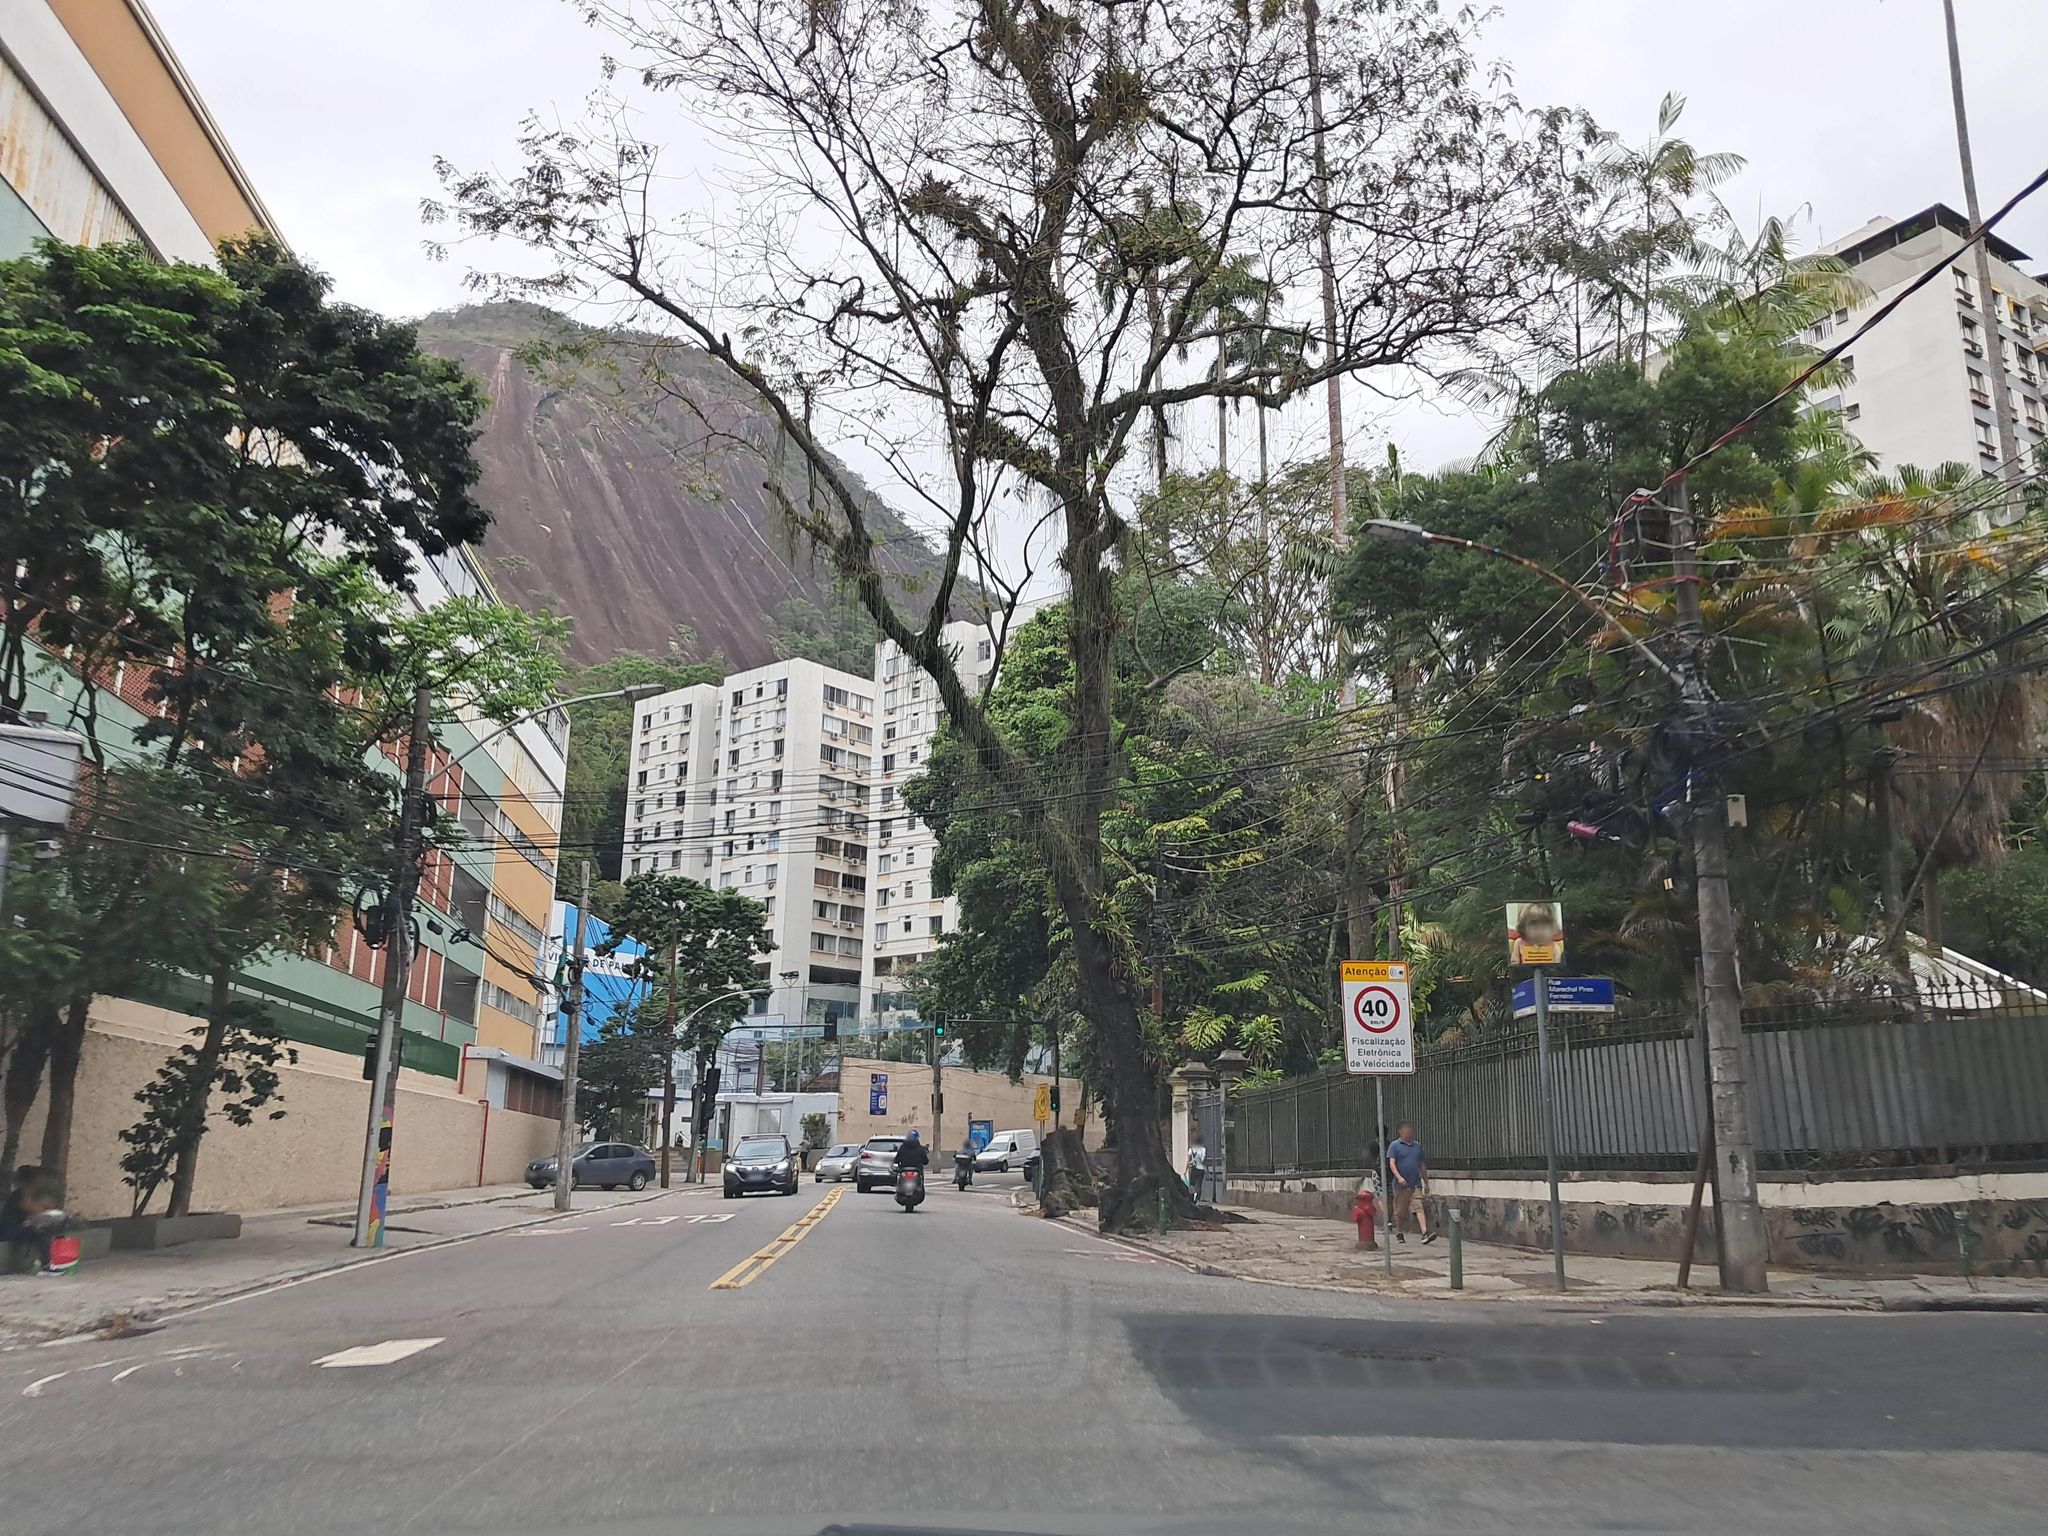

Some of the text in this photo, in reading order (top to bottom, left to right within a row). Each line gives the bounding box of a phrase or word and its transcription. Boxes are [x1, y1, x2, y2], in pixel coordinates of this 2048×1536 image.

[593, 959, 605, 968] DE
[1345, 967, 1387, 977] Atenção
[1362, 1000, 1387, 1017] 40
[1352, 1037, 1405, 1047] Fiscalização
[1358, 1048, 1402, 1057] Eletrônica
[1350, 1059, 1411, 1068] de Velocidade
